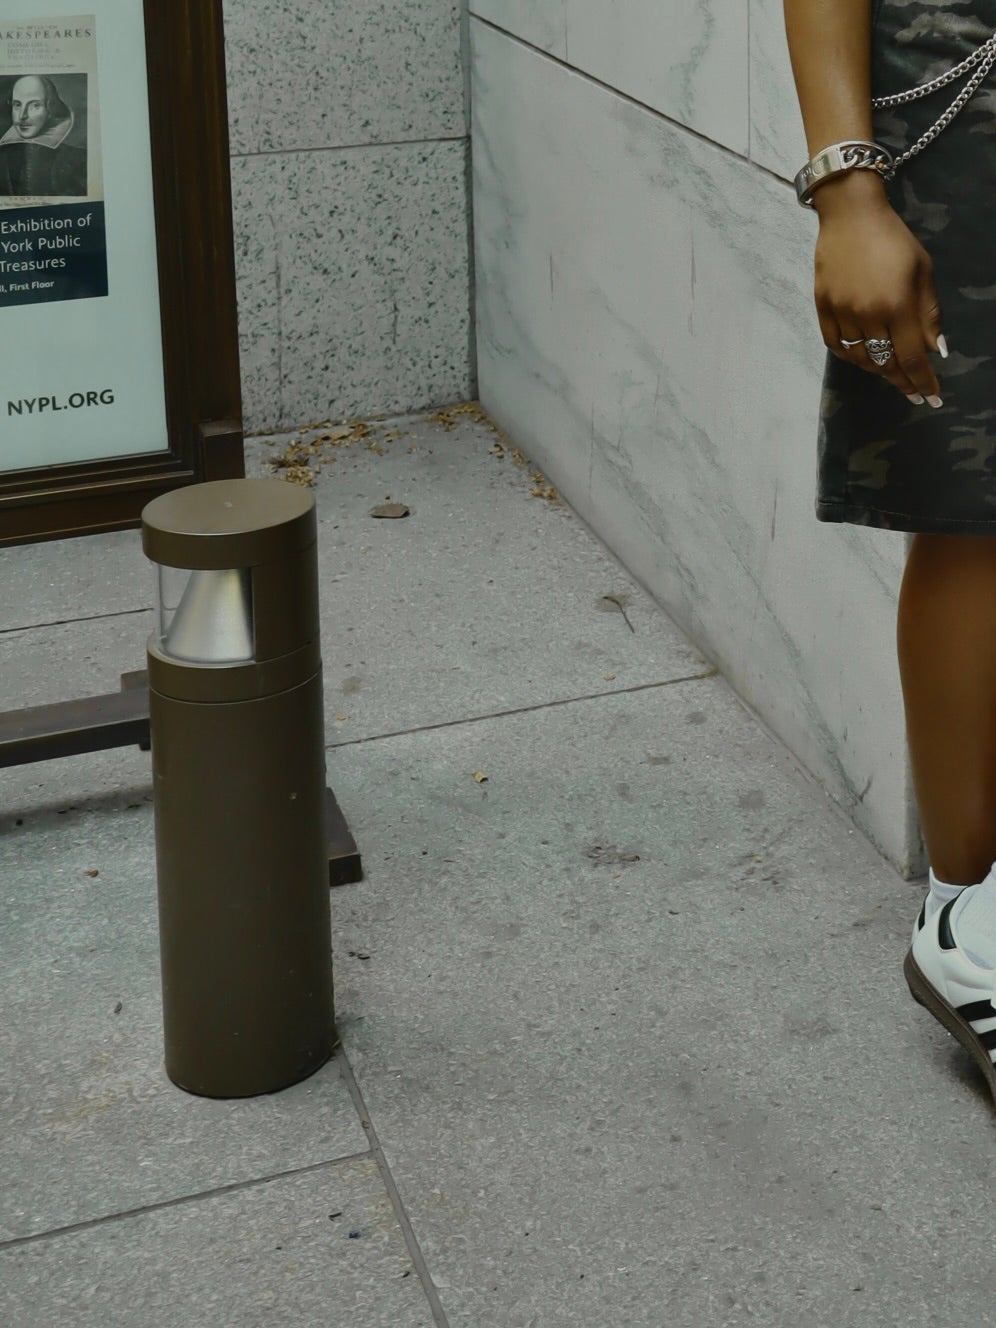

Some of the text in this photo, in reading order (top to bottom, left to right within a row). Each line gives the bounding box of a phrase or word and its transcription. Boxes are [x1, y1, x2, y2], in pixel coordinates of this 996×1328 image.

[1, 213, 92, 234] Exhibition of
[1, 235, 80, 253] York Public
[0, 257, 66, 273] Treasures
[9, 282, 30, 292] First
[31, 280, 54, 290] Floor
[7, 389, 115, 416] NYPL.ORG
